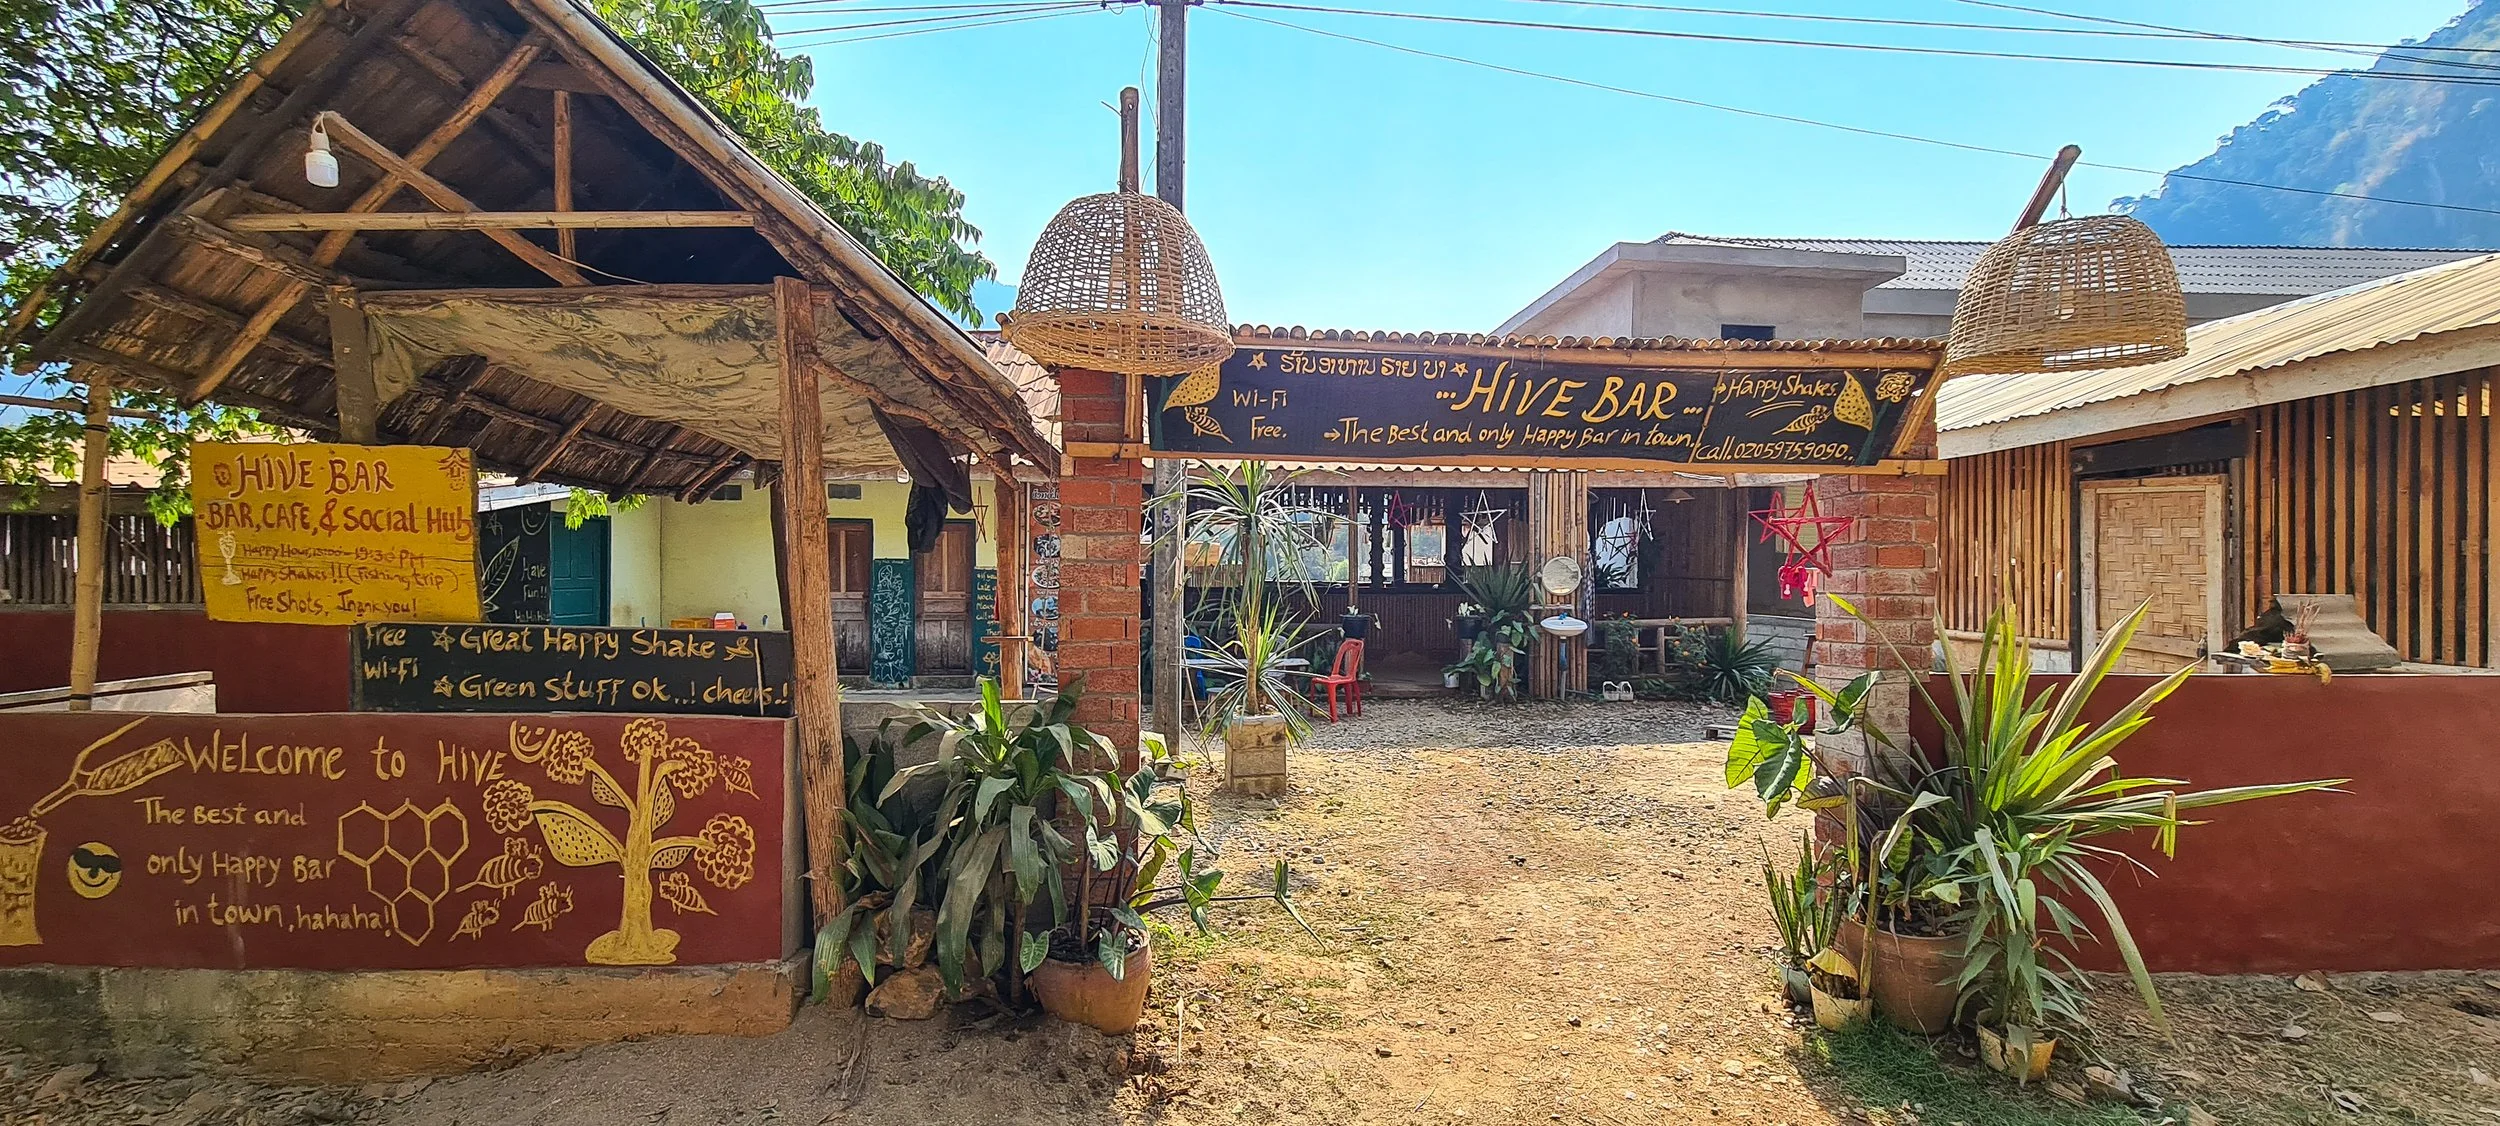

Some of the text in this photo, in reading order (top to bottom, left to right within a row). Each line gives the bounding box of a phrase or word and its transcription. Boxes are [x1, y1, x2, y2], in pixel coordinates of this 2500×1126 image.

[1232, 389, 1288, 410] Wi-Fi
[1721, 374, 1783, 404] Happy
[1339, 416, 1382, 445] The
[1387, 420, 1429, 445] Best
[1433, 420, 1473, 445] and
[1478, 422, 1516, 449] only
[1522, 423, 1577, 450] Happy
[1576, 427, 1619, 449] Bar
[1621, 428, 1641, 445] in
[324, 458, 396, 496] BAR
[318, 497, 339, 538] &
[242, 543, 279, 560] Happy
[241, 567, 278, 584] Happy
[246, 585, 274, 614] Free
[365, 622, 407, 650] Free
[459, 626, 534, 655] Great
[543, 626, 620, 660] Happy
[630, 628, 716, 660] Shake
[459, 673, 537, 701] Green
[370, 735, 406, 781] to
[133, 796, 185, 826] The
[254, 800, 307, 827] and
[147, 845, 336, 888] only Happy Bar
[174, 898, 199, 926] in
